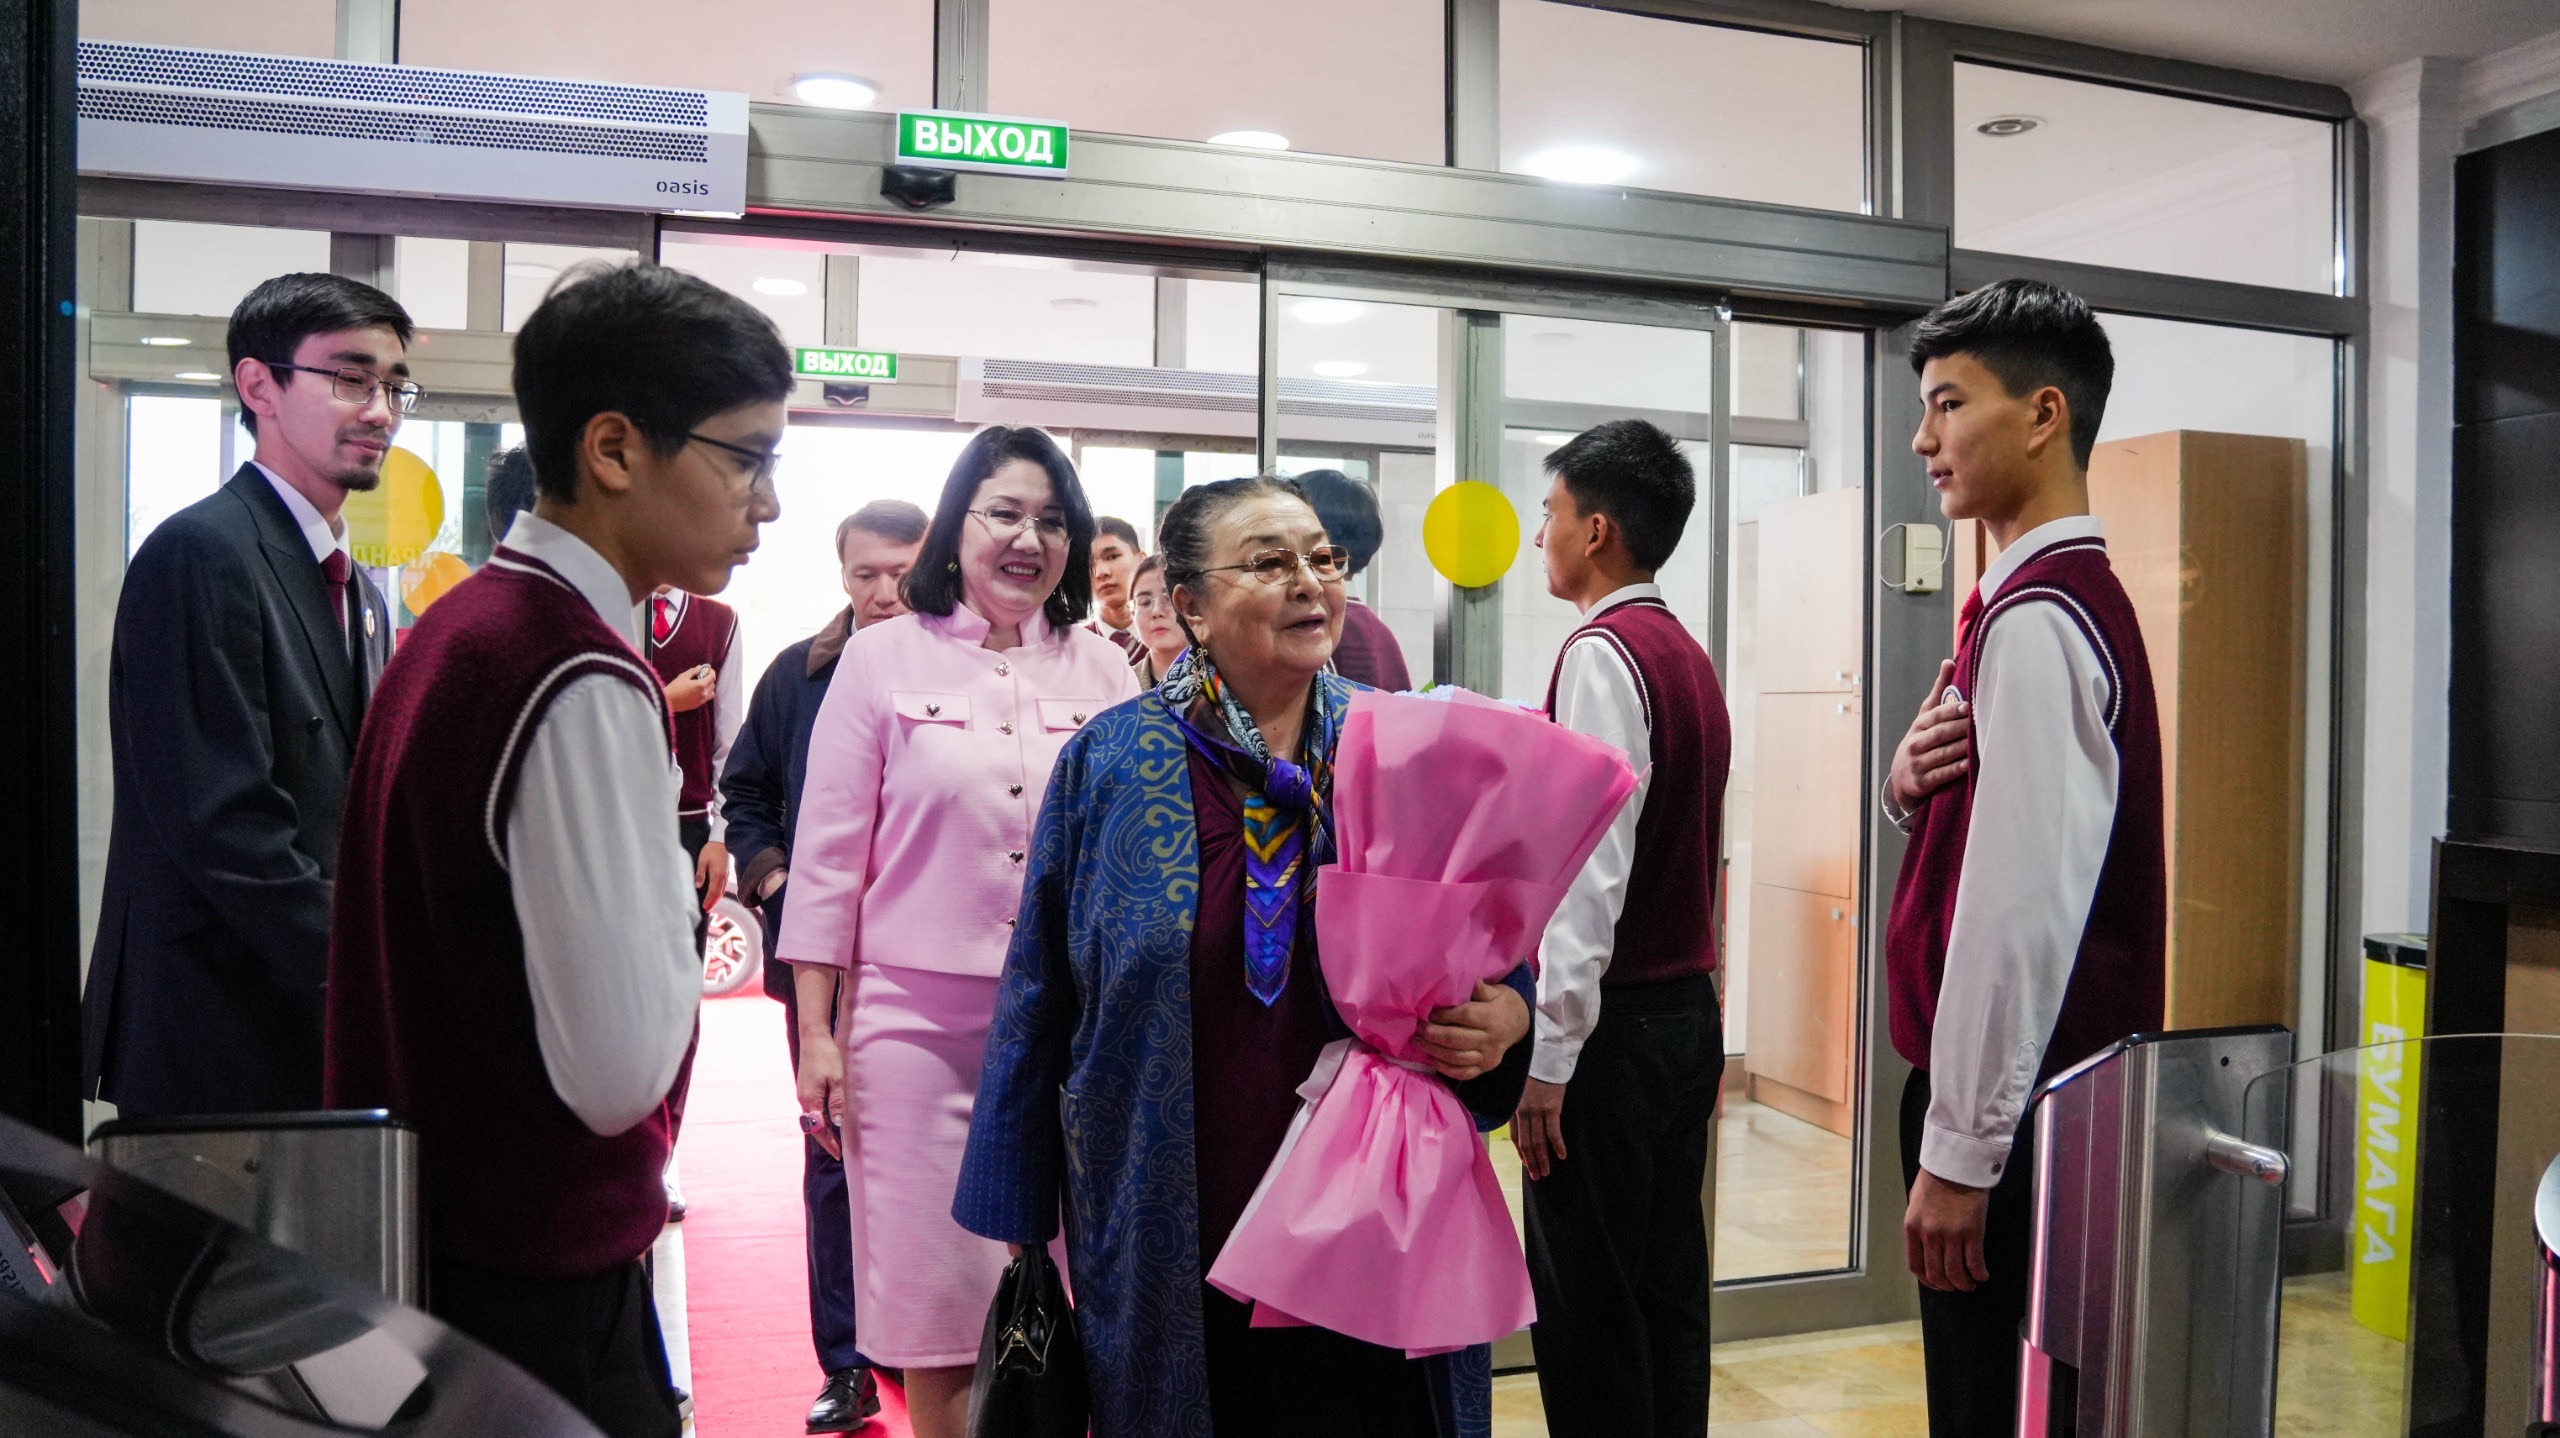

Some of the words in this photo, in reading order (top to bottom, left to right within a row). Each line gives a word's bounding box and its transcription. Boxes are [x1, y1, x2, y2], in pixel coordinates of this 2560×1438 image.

[914, 119, 1054, 164] ВЫХОД
[656, 179, 709, 195] oasis
[803, 351, 889, 377] ВЫХОД
[2361, 1022, 2405, 1265] БУМАГА
